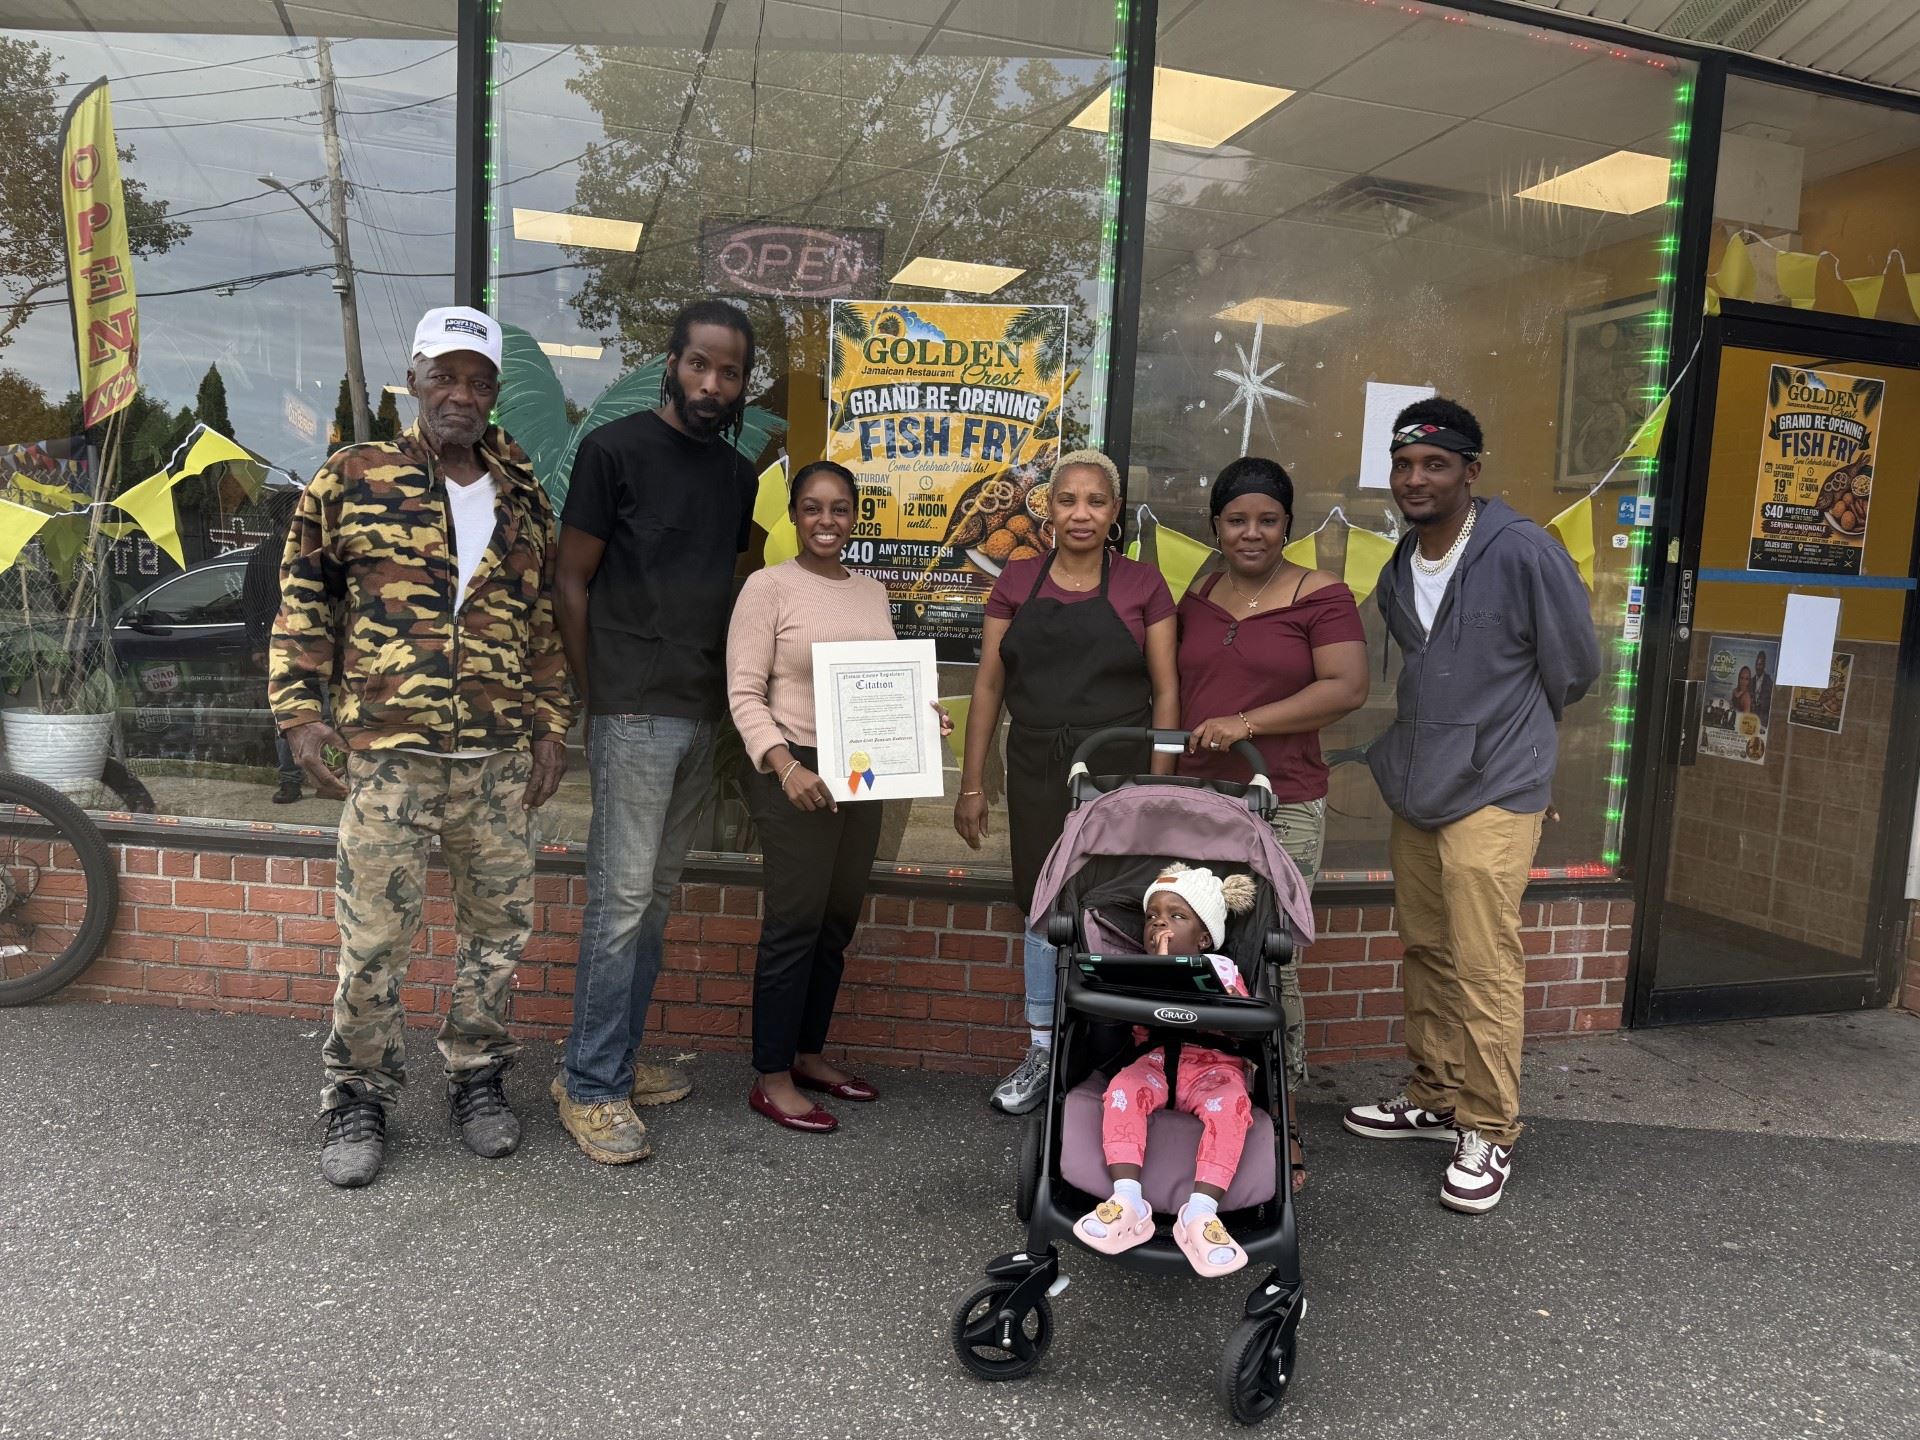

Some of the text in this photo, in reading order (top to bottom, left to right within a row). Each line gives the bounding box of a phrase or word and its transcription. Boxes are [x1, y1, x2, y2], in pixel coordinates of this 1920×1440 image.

[69, 143, 136, 368] OPEN
[719, 241, 865, 283] OPEN
[862, 337, 1023, 368] GOLDEN
[861, 365, 955, 378] Jamaican Restaurant
[960, 362, 1025, 386] Crest
[850, 386, 1041, 421] GRAND RE-OPENING
[1787, 384, 1860, 409] GOLDEN
[1830, 403, 1859, 420] Crest
[1779, 414, 1864, 440] GRAND RE-OPENING
[859, 416, 1033, 467] FISH FRY
[1780, 431, 1860, 464] FISH FRY
[888, 460, 989, 474] Come Celebrate With Us!
[854, 473, 890, 484] ATURDAY
[908, 493, 944, 502] STARTING AT
[1772, 493, 1788, 502] 2026
[861, 498, 887, 521] 9TH
[903, 502, 947, 518] 12 NOON
[1764, 503, 1784, 519] $40
[1795, 508, 1809, 516] STYLE
[851, 522, 882, 537] 2026
[907, 519, 938, 530] until...
[1770, 521, 1826, 533] SERVING UNIONDALE
[840, 541, 954, 564] $40 ANY STYLE FISH
[892, 556, 940, 567] WITH 2 SIDES
[850, 568, 973, 584] RVING UNIONDALE
[889, 582, 912, 590] over
[1681, 572, 1691, 607] PULL
[888, 591, 907, 600] AICAN
[908, 592, 933, 601] FLAVOR
[927, 610, 960, 619] UNIONDALE,
[928, 631, 966, 639] celebrate
[153, 679, 173, 690] DRY
[855, 679, 894, 690] Citation
[1160, 1009, 1194, 1021] GRACO
